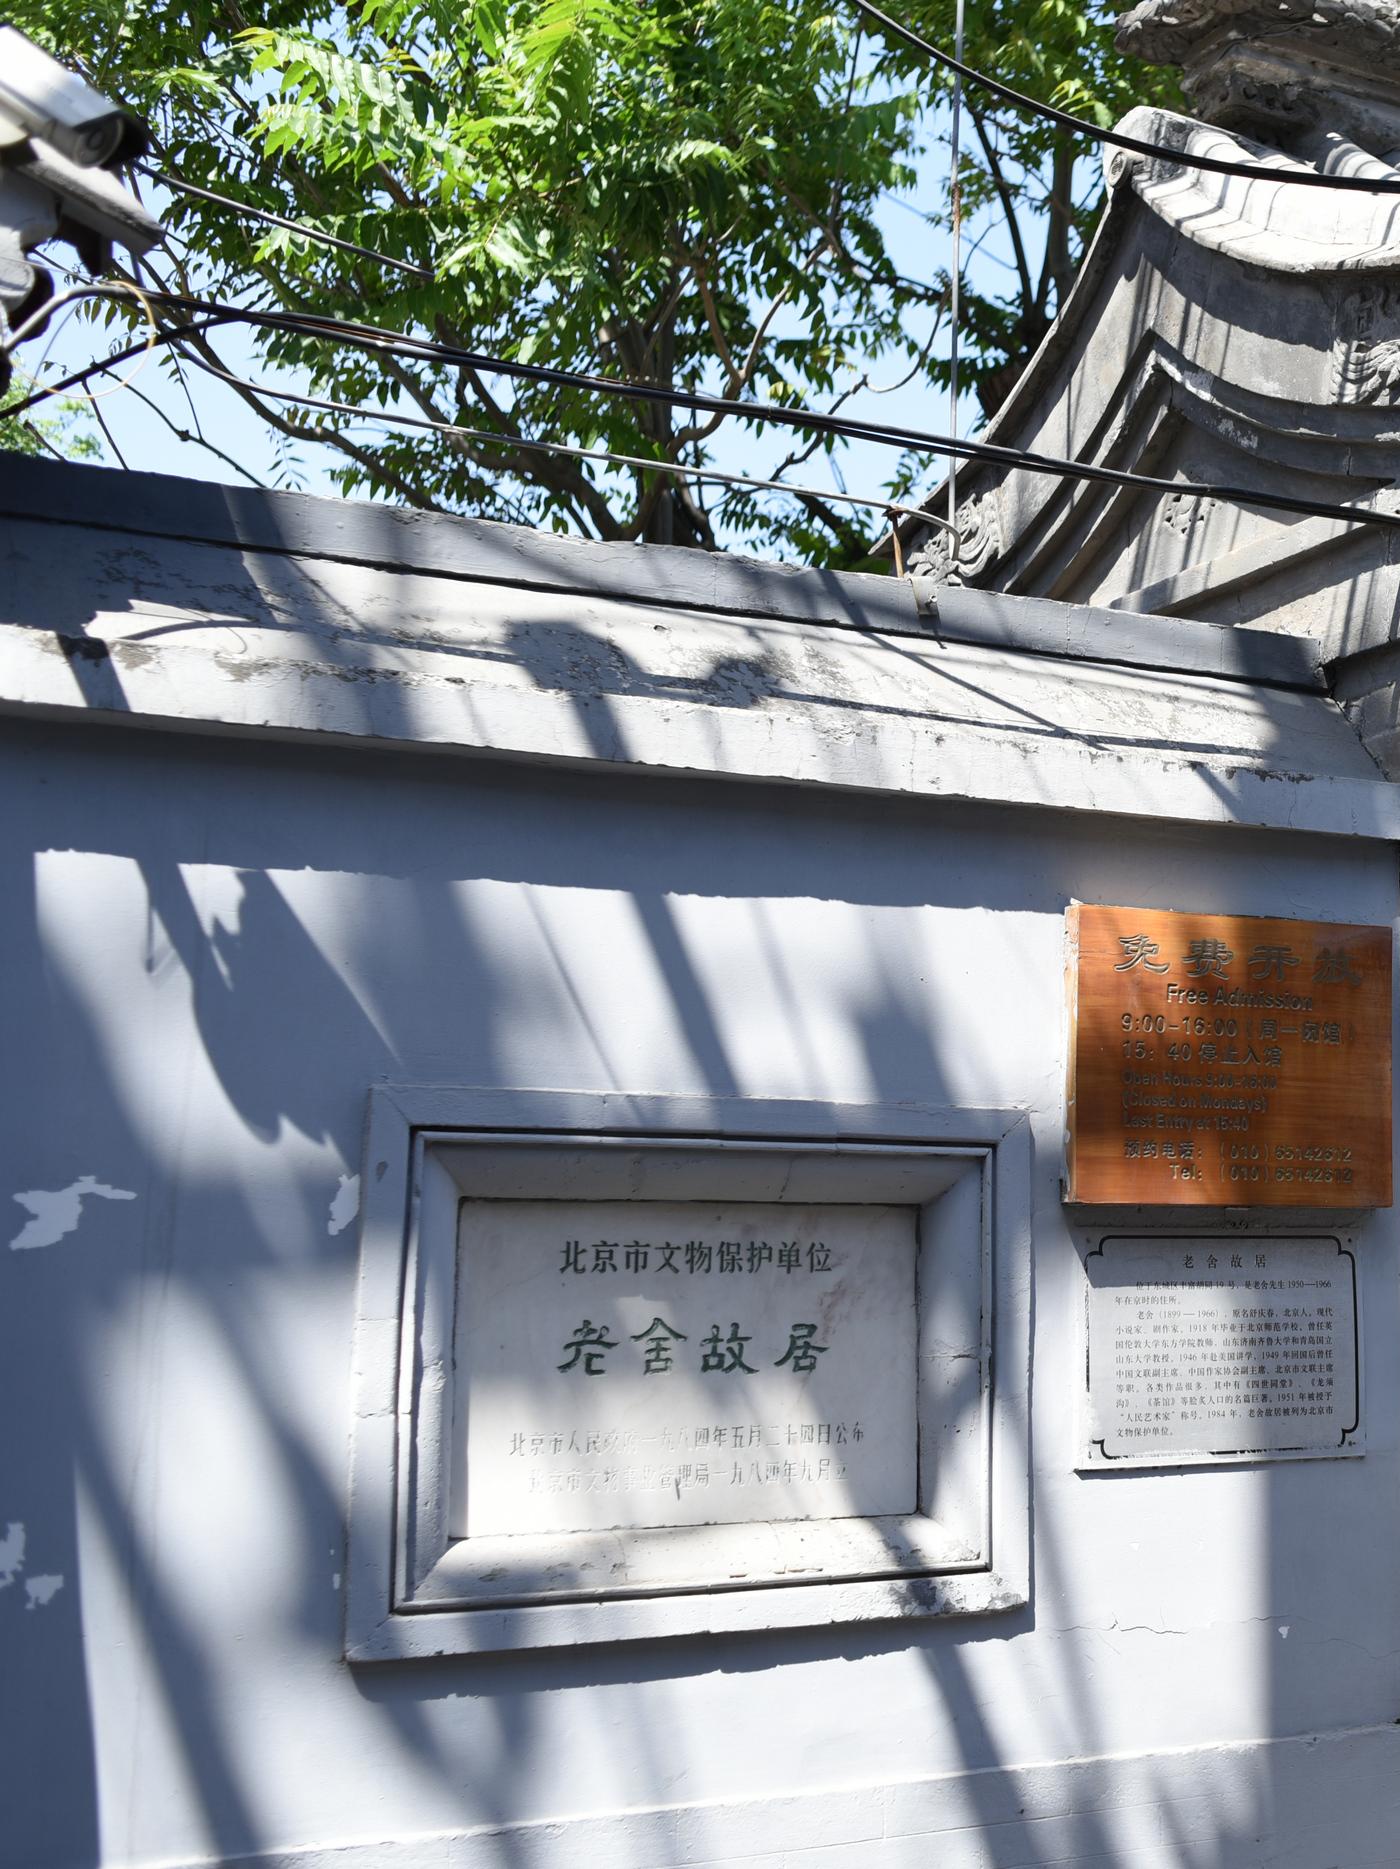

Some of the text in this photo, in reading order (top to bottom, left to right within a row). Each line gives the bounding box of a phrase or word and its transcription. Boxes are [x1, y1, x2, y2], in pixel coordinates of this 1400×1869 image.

[1113, 933, 1362, 987] 免费开放
[1167, 983, 1313, 1011] Free Admission
[559, 1240, 833, 1275] 北京市文物保护单位
[1182, 1254, 1268, 1270] 老舍故居
[557, 1318, 831, 1376] 老舍故居
